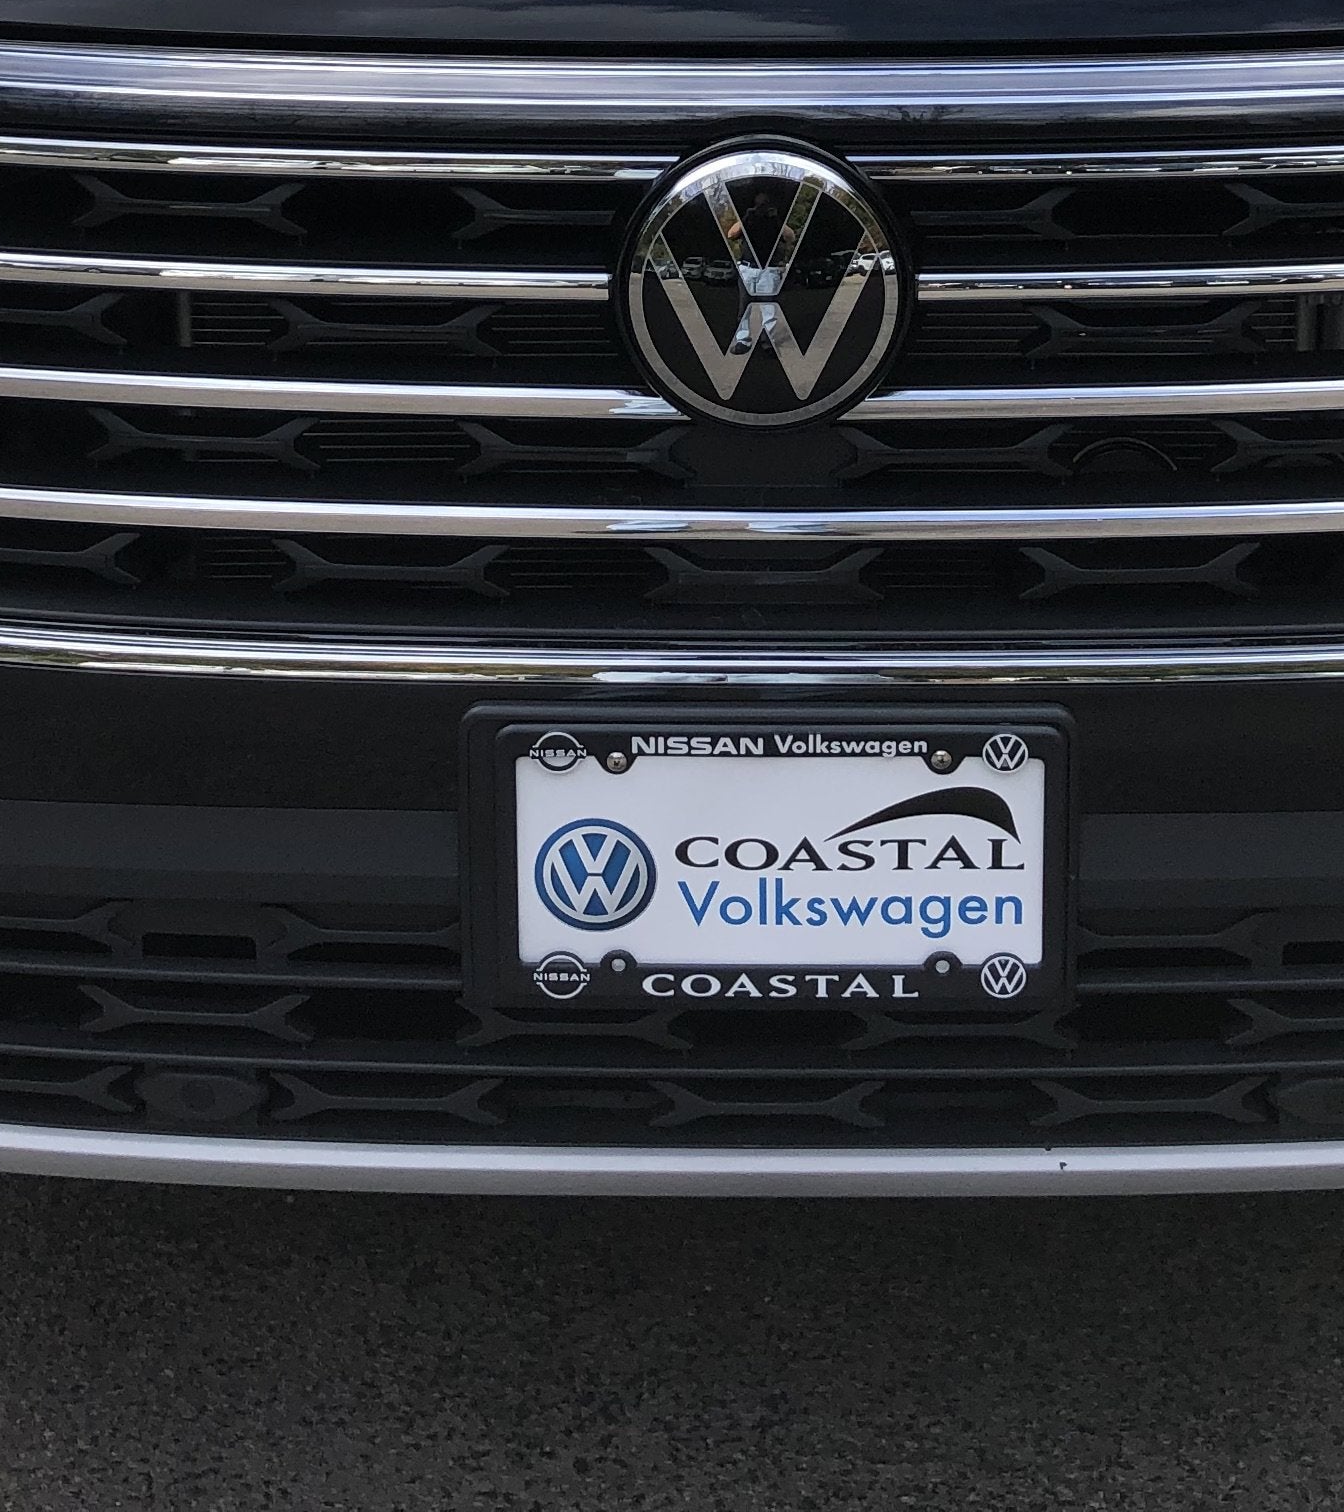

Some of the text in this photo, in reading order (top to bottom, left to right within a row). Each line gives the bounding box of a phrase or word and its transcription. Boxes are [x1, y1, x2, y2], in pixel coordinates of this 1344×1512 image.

[530, 748, 587, 759] NISSAN
[631, 734, 928, 758] NISSAN Volkswagen
[674, 836, 1025, 871] COASTAL
[677, 877, 1023, 938] Volkswagen
[533, 972, 591, 983] NISSAN
[641, 973, 920, 999] COASTAL
